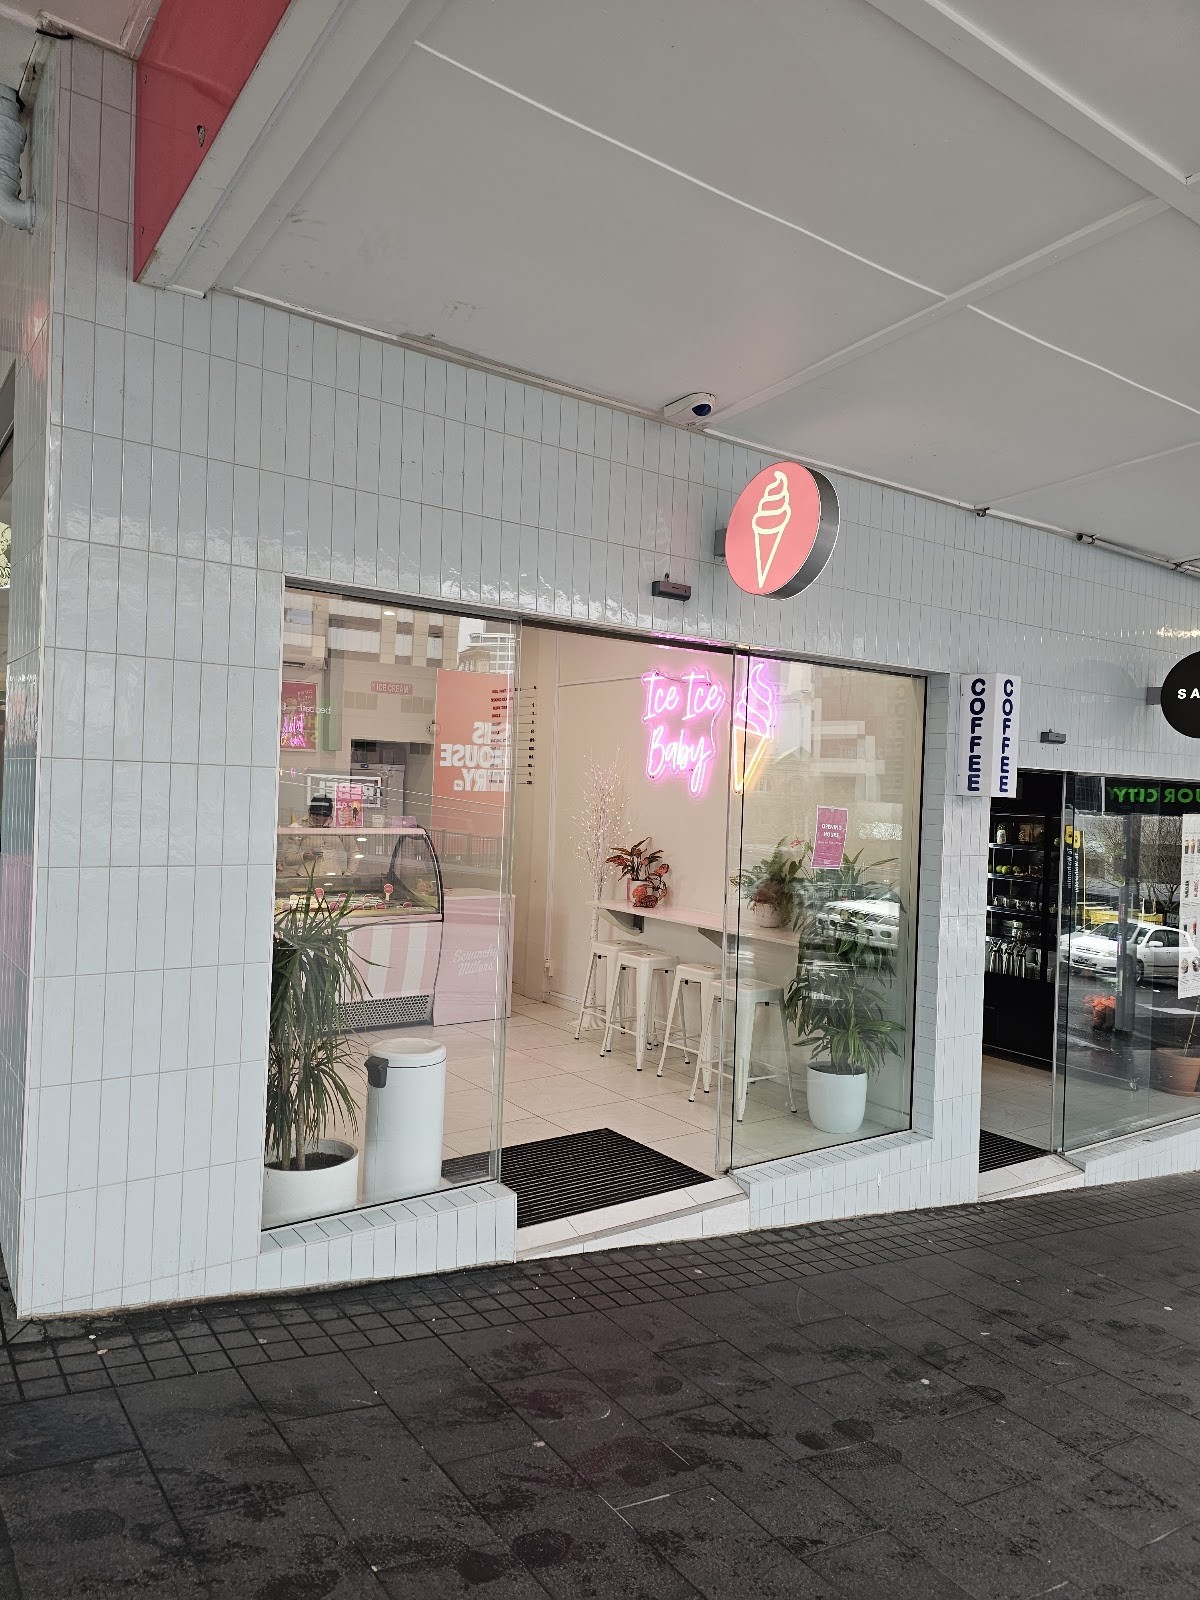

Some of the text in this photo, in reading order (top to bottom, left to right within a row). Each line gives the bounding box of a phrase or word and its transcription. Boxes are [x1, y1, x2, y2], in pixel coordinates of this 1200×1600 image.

[643, 672, 721, 721] Ice Ice
[967, 678, 986, 792] COFFEE
[999, 678, 1014, 793] COFFEE
[647, 726, 712, 793] Baby
